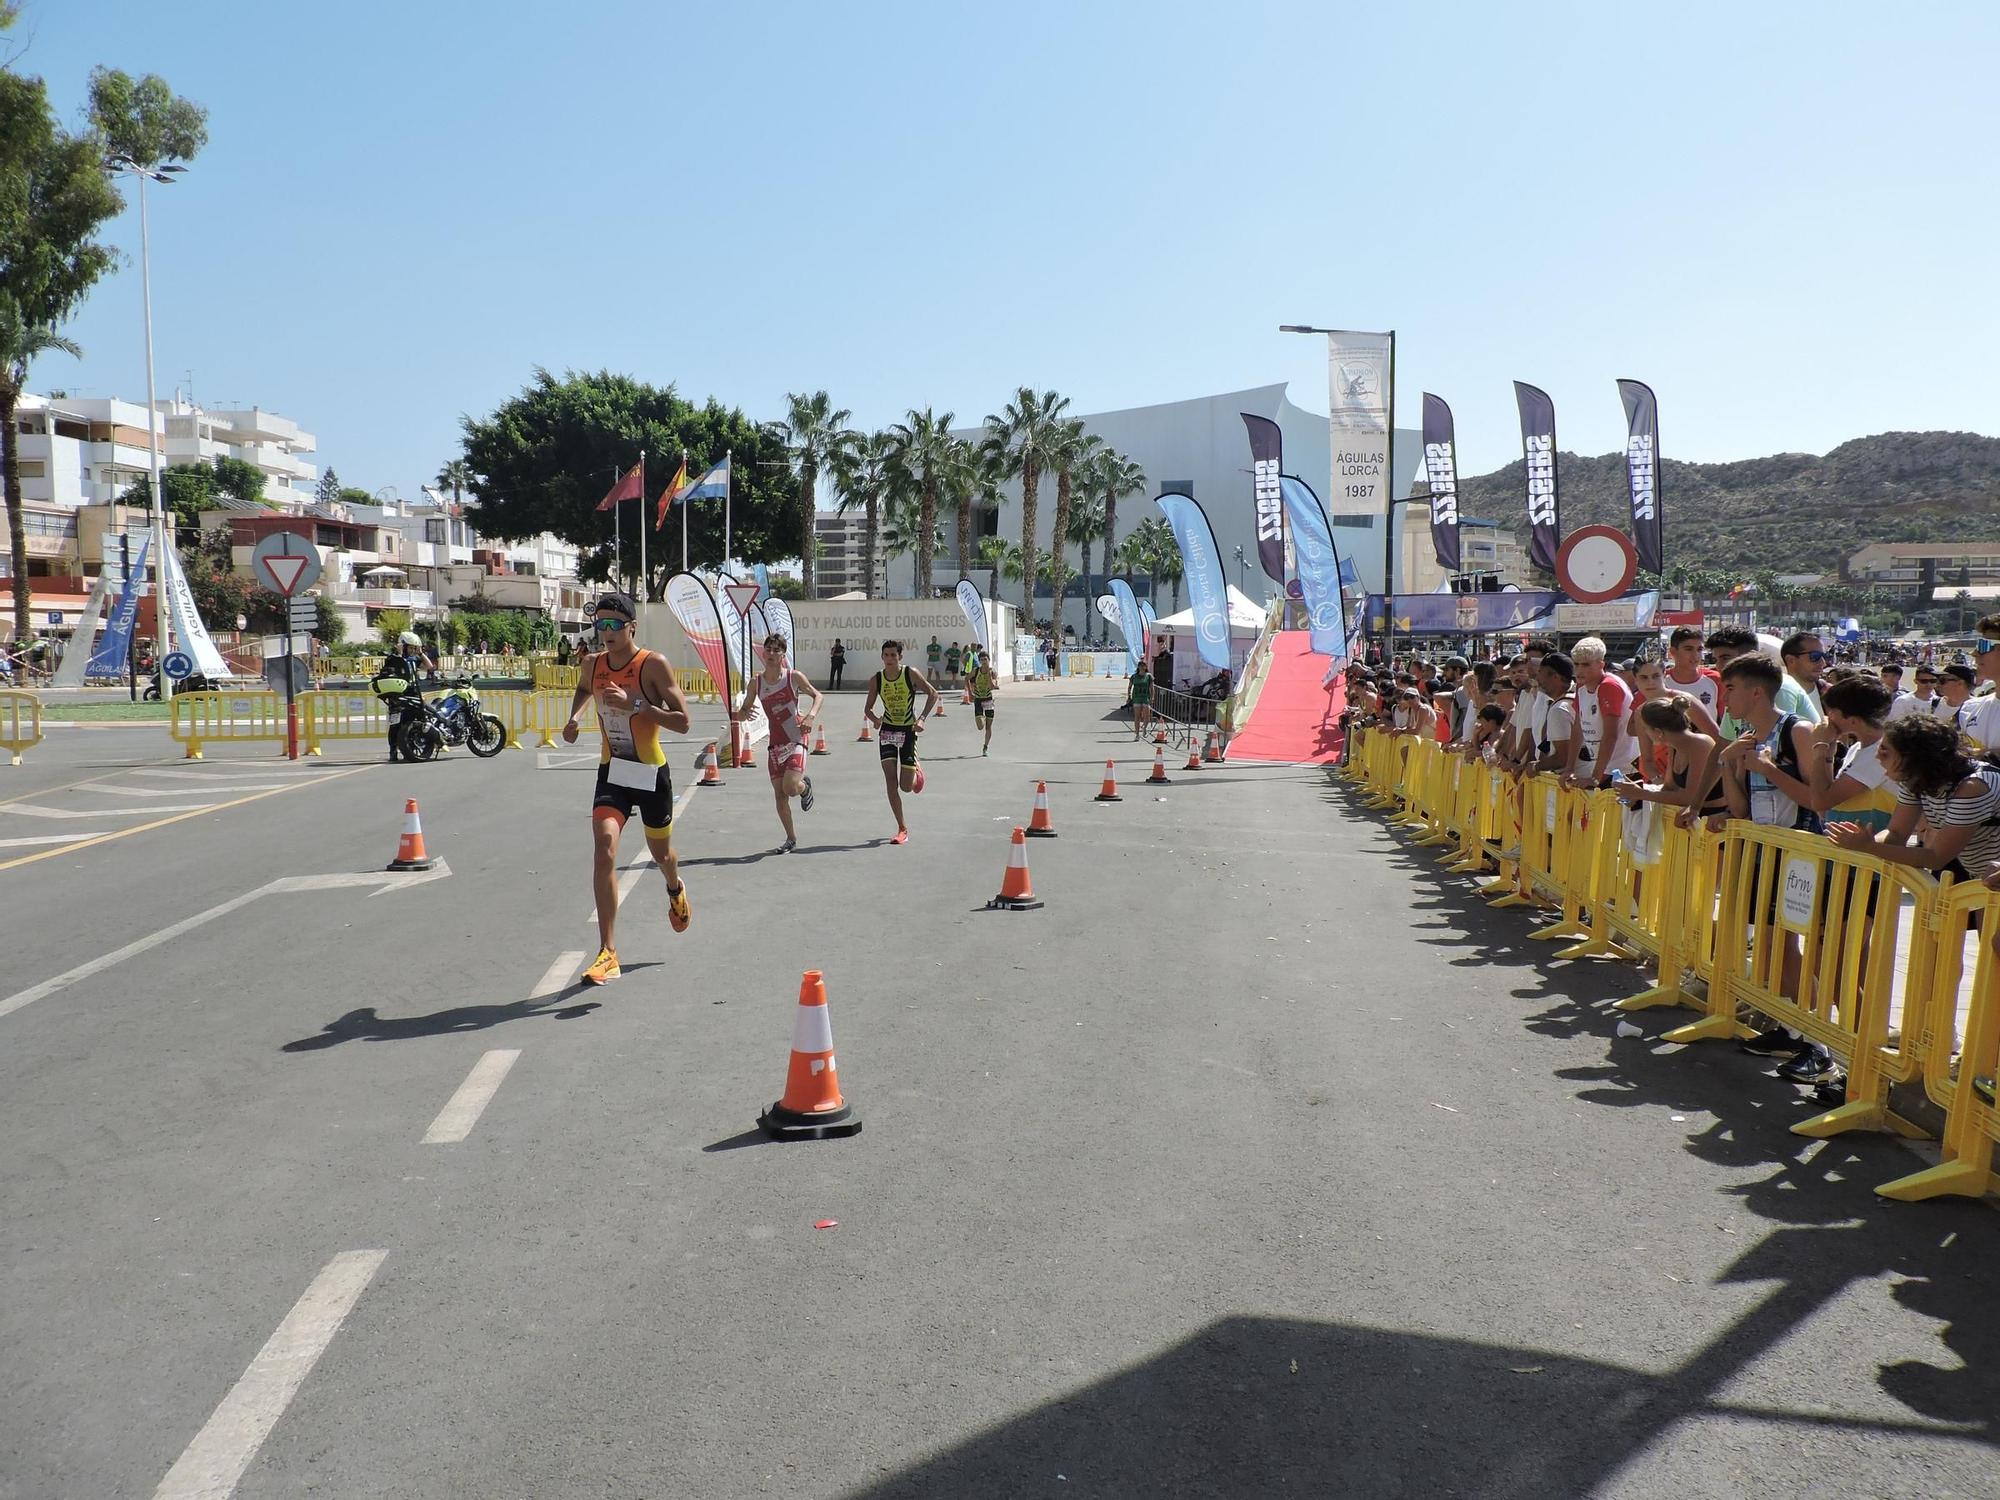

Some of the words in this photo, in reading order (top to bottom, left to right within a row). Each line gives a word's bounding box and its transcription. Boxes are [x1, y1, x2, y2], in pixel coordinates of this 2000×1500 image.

[1336, 449, 1385, 464] ÁGUILAS
[1341, 465, 1380, 476] LORCA
[1344, 484, 1375, 498] 1987
[115, 577, 142, 635] ÁGUILAS
[175, 578, 203, 639] ÁGUILAS
[51, 613, 60, 622] P
[813, 616, 820, 629] Y
[824, 616, 873, 630] PALACIO
[876, 615, 891, 629] DE
[895, 614, 967, 628] CONGRESOS
[846, 637, 879, 651] DOÑA
